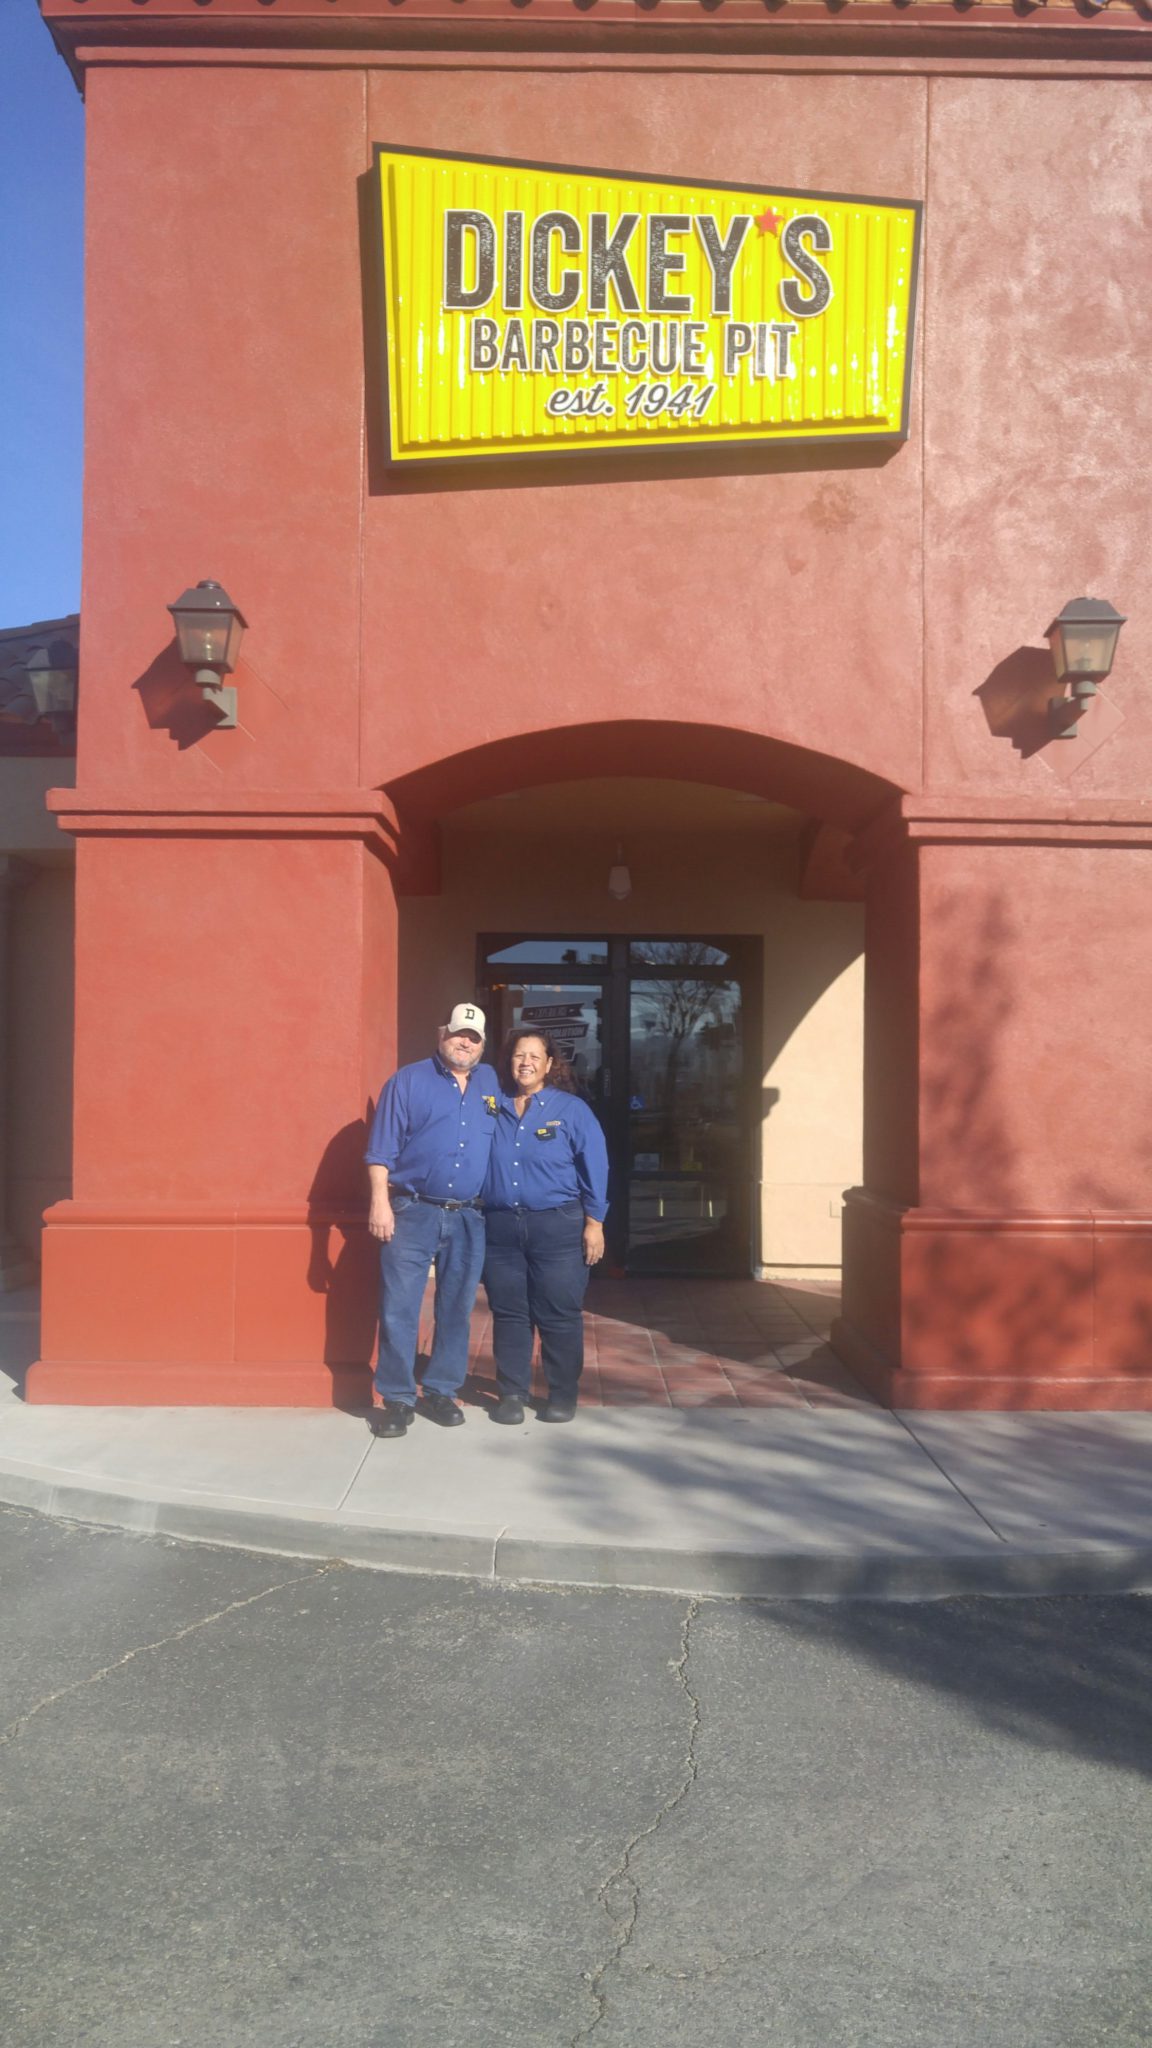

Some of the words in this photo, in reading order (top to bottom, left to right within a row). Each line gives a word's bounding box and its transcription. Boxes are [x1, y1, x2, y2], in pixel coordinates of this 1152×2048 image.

[443, 209, 834, 317] DICKEY'S
[471, 318, 707, 375] BARBECUE
[724, 322, 798, 376] PIT
[547, 382, 615, 415] est.
[624, 383, 716, 416] 1941
[465, 1008, 475, 1020] D
